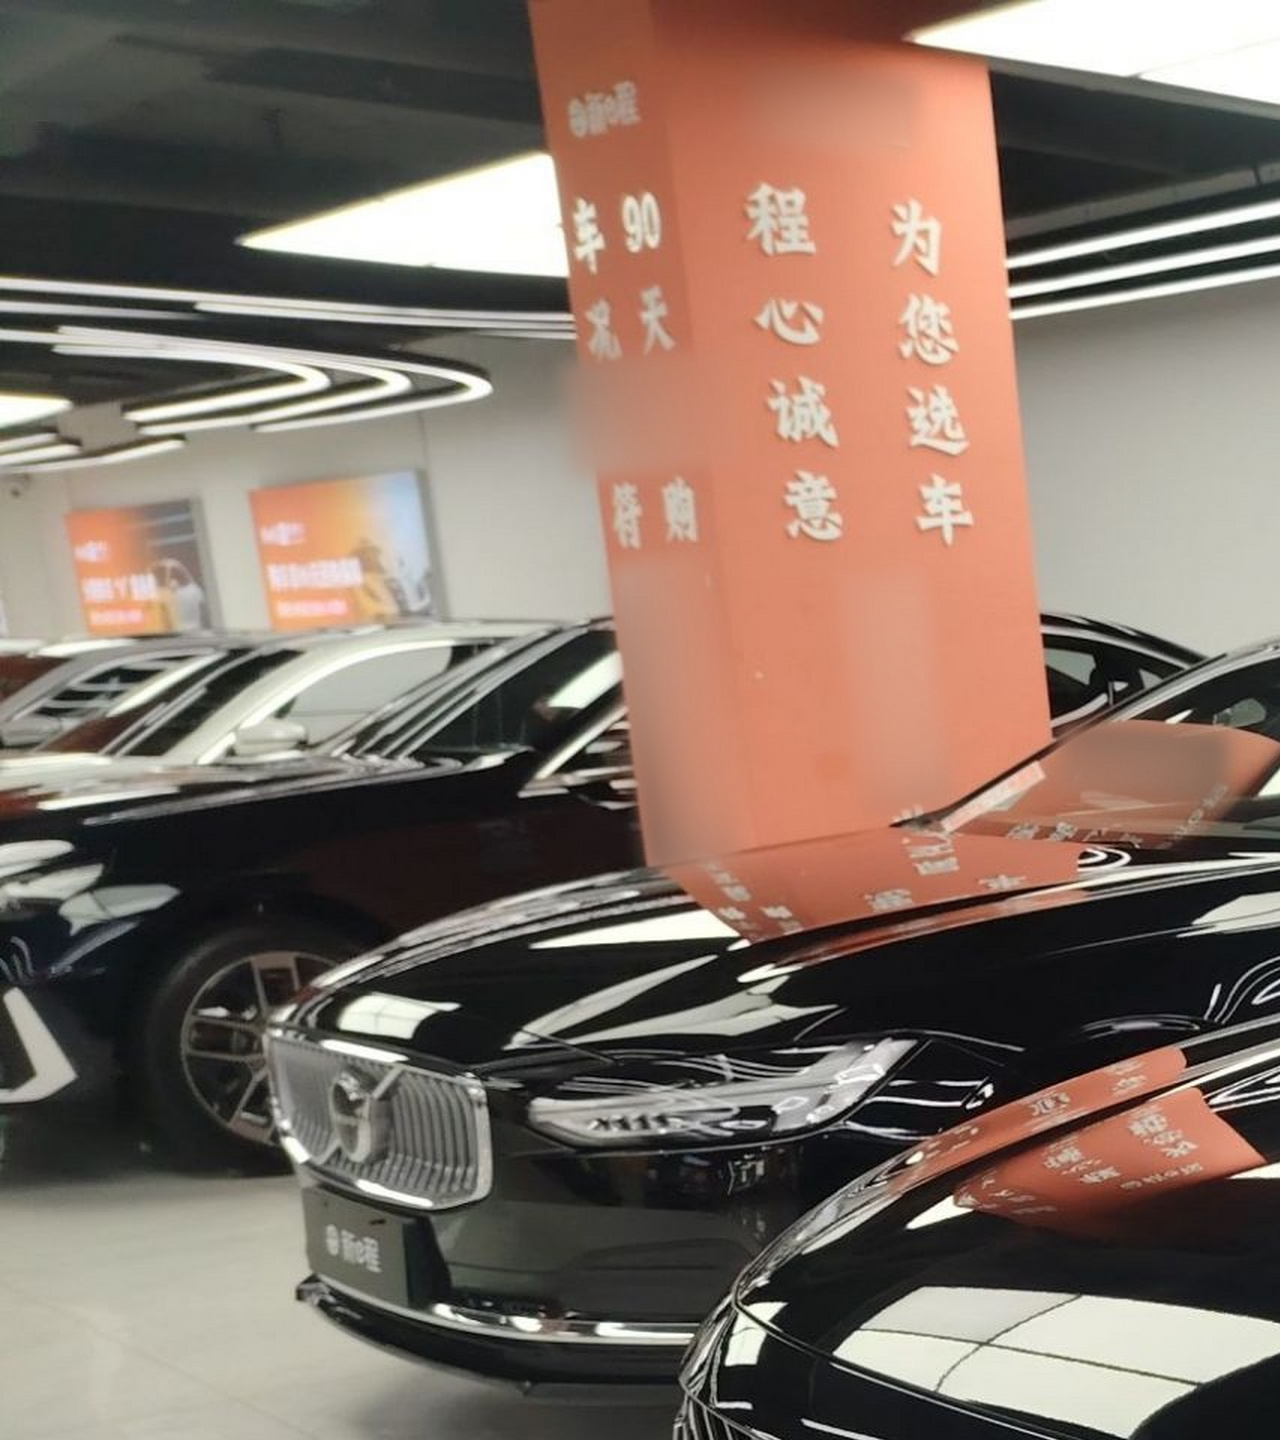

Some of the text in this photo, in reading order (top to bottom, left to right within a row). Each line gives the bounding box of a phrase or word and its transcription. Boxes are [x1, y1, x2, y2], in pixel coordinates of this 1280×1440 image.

[745, 182, 842, 542] 程心诚意
[891, 199, 973, 547] 为您选车
